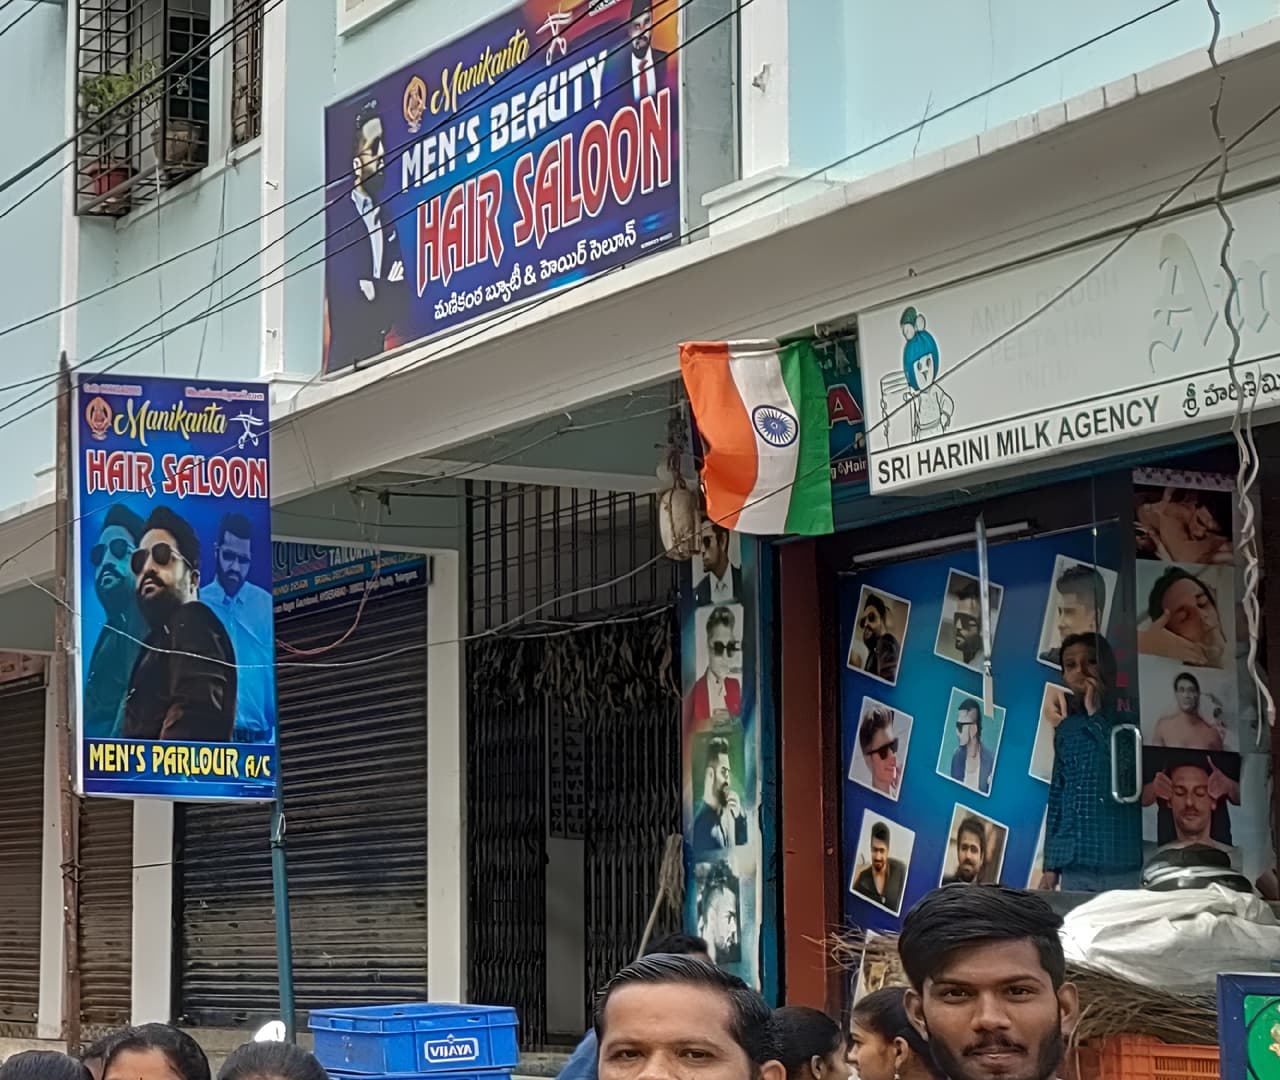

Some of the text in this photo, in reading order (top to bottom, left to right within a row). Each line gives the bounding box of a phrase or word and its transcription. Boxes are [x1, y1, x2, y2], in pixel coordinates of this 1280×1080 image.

[430, 27, 530, 116] Manikanta
[401, 49, 608, 195] MEN'S BEAUTY
[416, 87, 672, 298] HAIR SALOON
[523, 264, 537, 286] &
[113, 397, 229, 446] Manikanta
[877, 395, 1160, 485] SRI HARINI MILK AGENCY
[87, 449, 269, 500] HAIR SALOON
[88, 742, 272, 779] MEN'S PARLOUR A/C
[429, 1043, 473, 1058] VIJAYA
